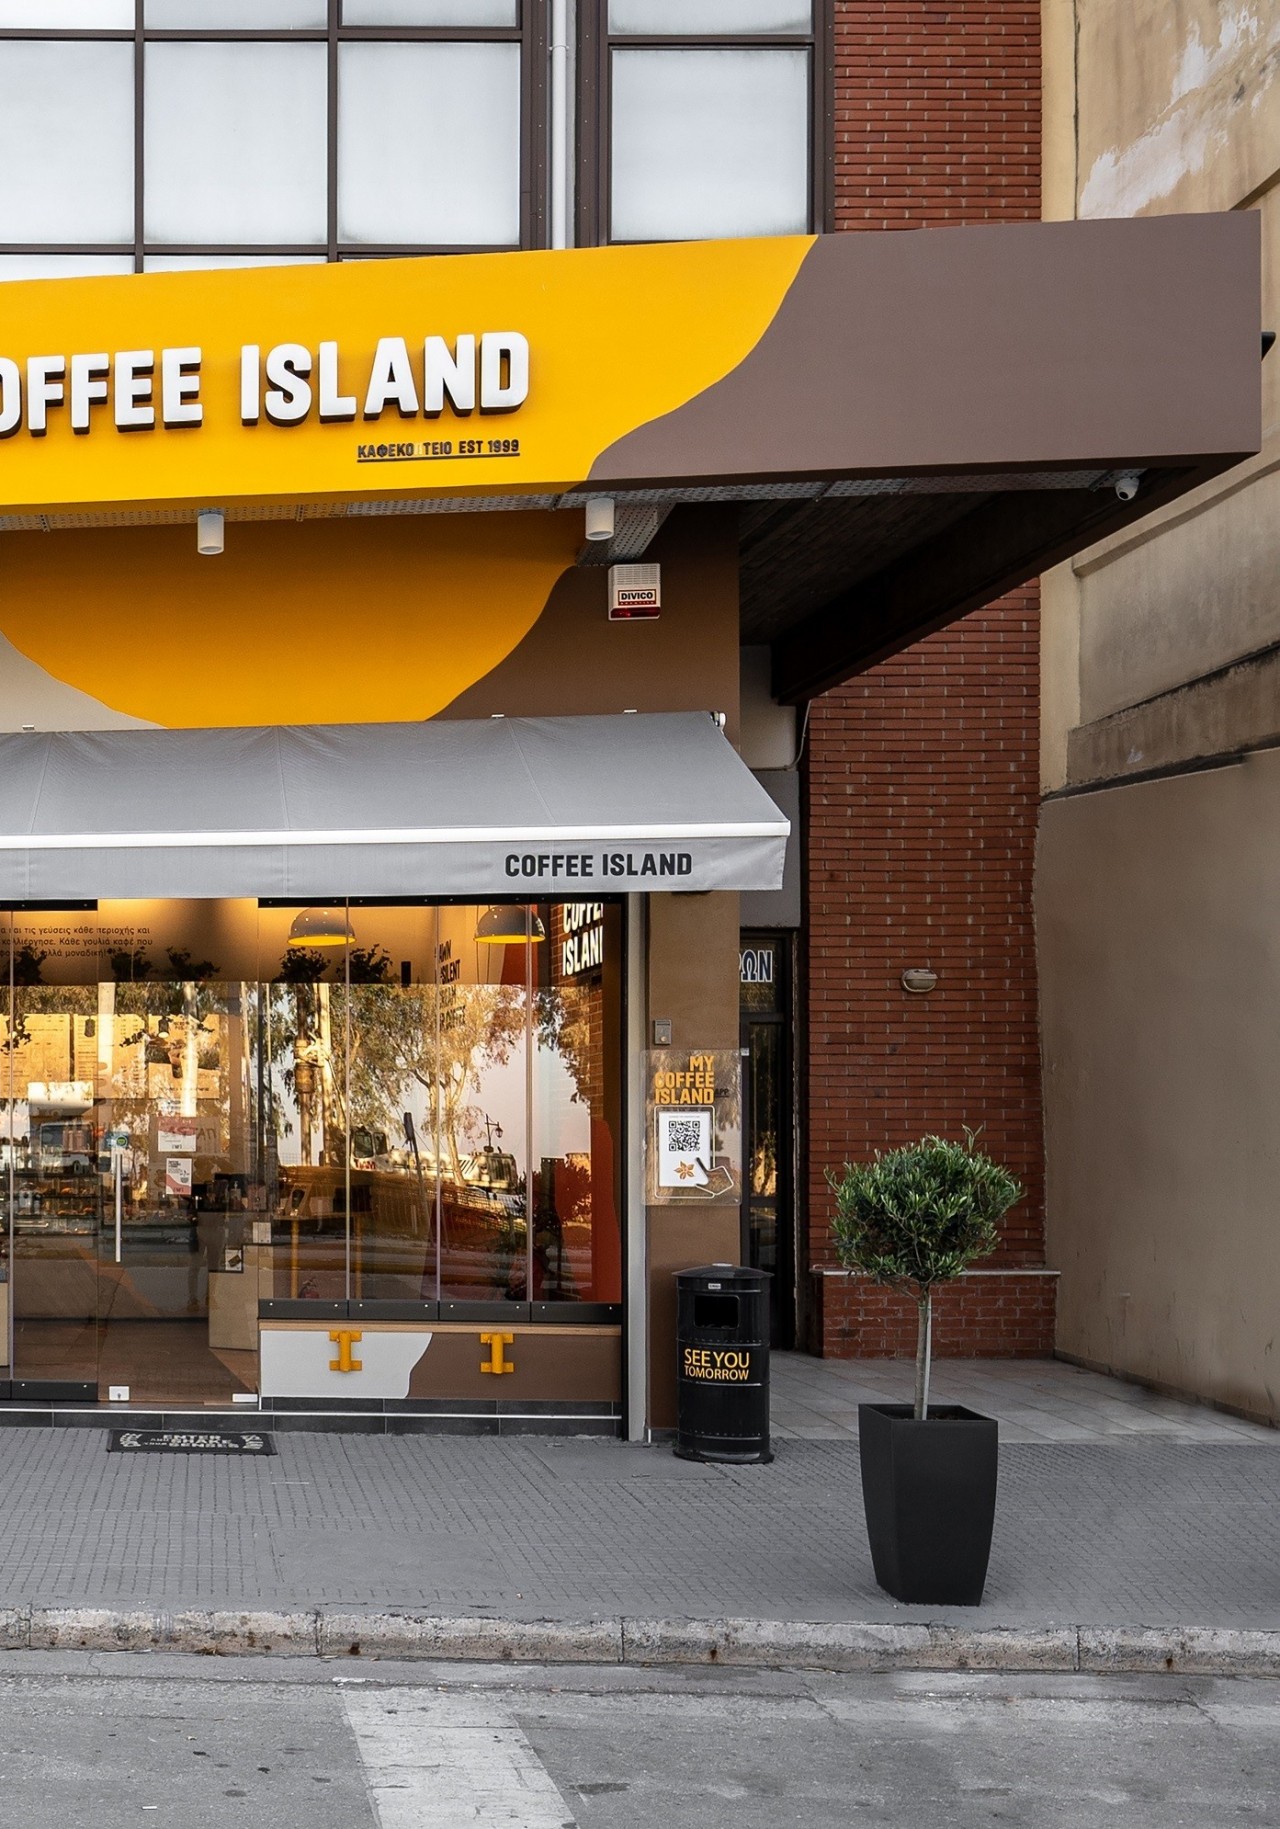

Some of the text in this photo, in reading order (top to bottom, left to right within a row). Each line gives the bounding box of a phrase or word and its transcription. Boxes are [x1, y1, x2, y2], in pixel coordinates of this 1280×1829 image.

[240, 331, 530, 427] ISLAND
[459, 440, 483, 454] EST
[487, 439, 519, 453] 1999
[621, 592, 653, 600] DIVICO
[505, 853, 692, 877] COFFEE ISLAND
[738, 949, 773, 982] ΩΝ
[689, 1055, 715, 1071] MY
[654, 1072, 715, 1088] COFFEE
[655, 1088, 715, 1105] ISLAND
[684, 1348, 750, 1368] SEE YOU
[684, 1365, 749, 1381] TOMORROW
